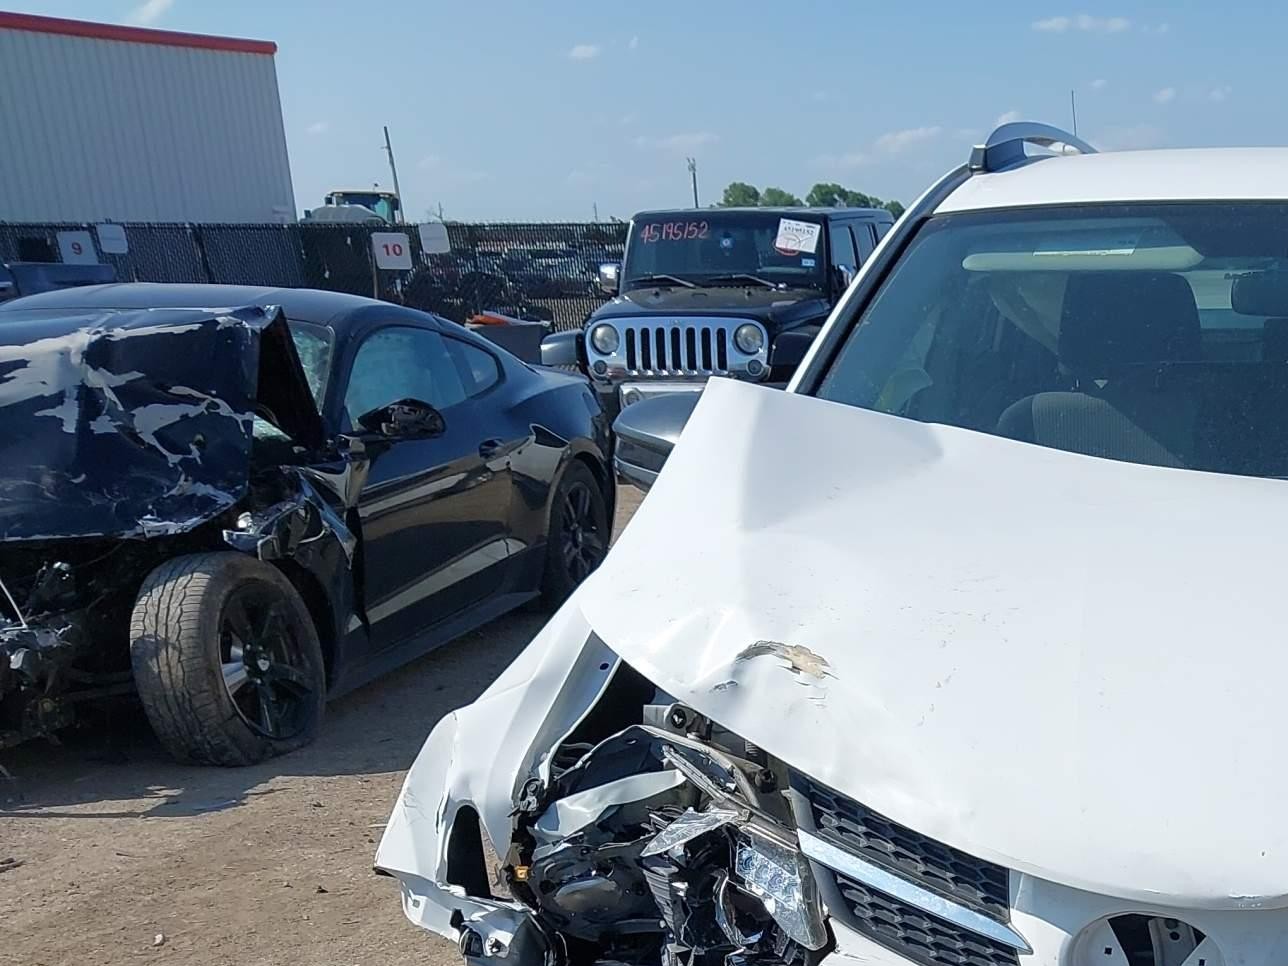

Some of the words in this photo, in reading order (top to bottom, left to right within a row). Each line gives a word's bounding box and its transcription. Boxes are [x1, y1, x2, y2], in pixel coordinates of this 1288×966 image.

[640, 221, 709, 244] 45195152
[71, 241, 83, 255] 9
[381, 242, 404, 257] 10
